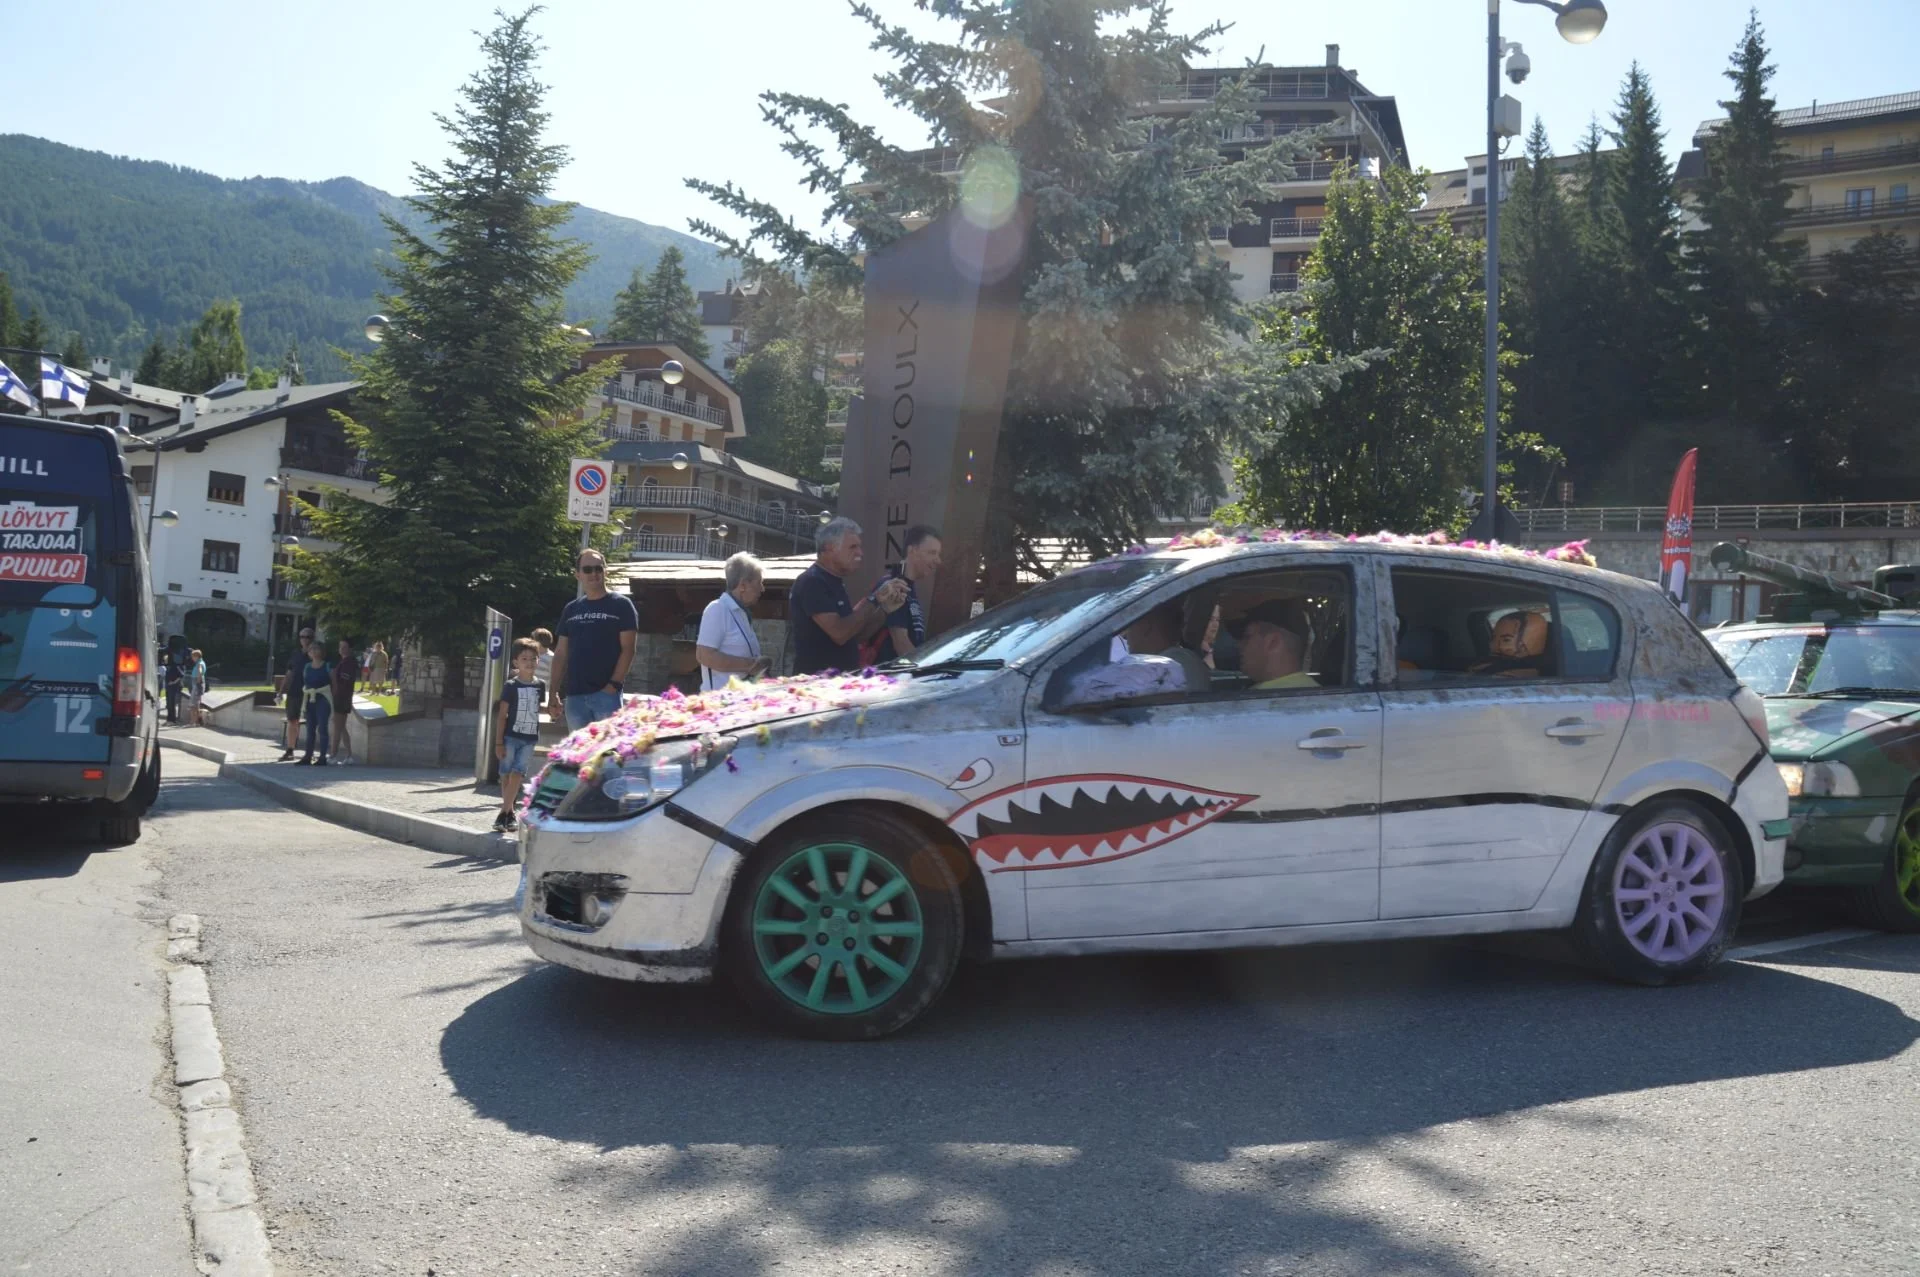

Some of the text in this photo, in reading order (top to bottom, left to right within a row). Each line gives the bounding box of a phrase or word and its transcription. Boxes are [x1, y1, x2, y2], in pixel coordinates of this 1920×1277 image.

[889, 300, 919, 480] D'OULX
[1, 506, 69, 528] LÖYLYT
[2, 533, 77, 550] TARJOAA
[0, 556, 80, 579] PUUILO!
[573, 611, 608, 621] HILFIGER
[490, 636, 502, 652] P
[53, 694, 92, 733] 12
